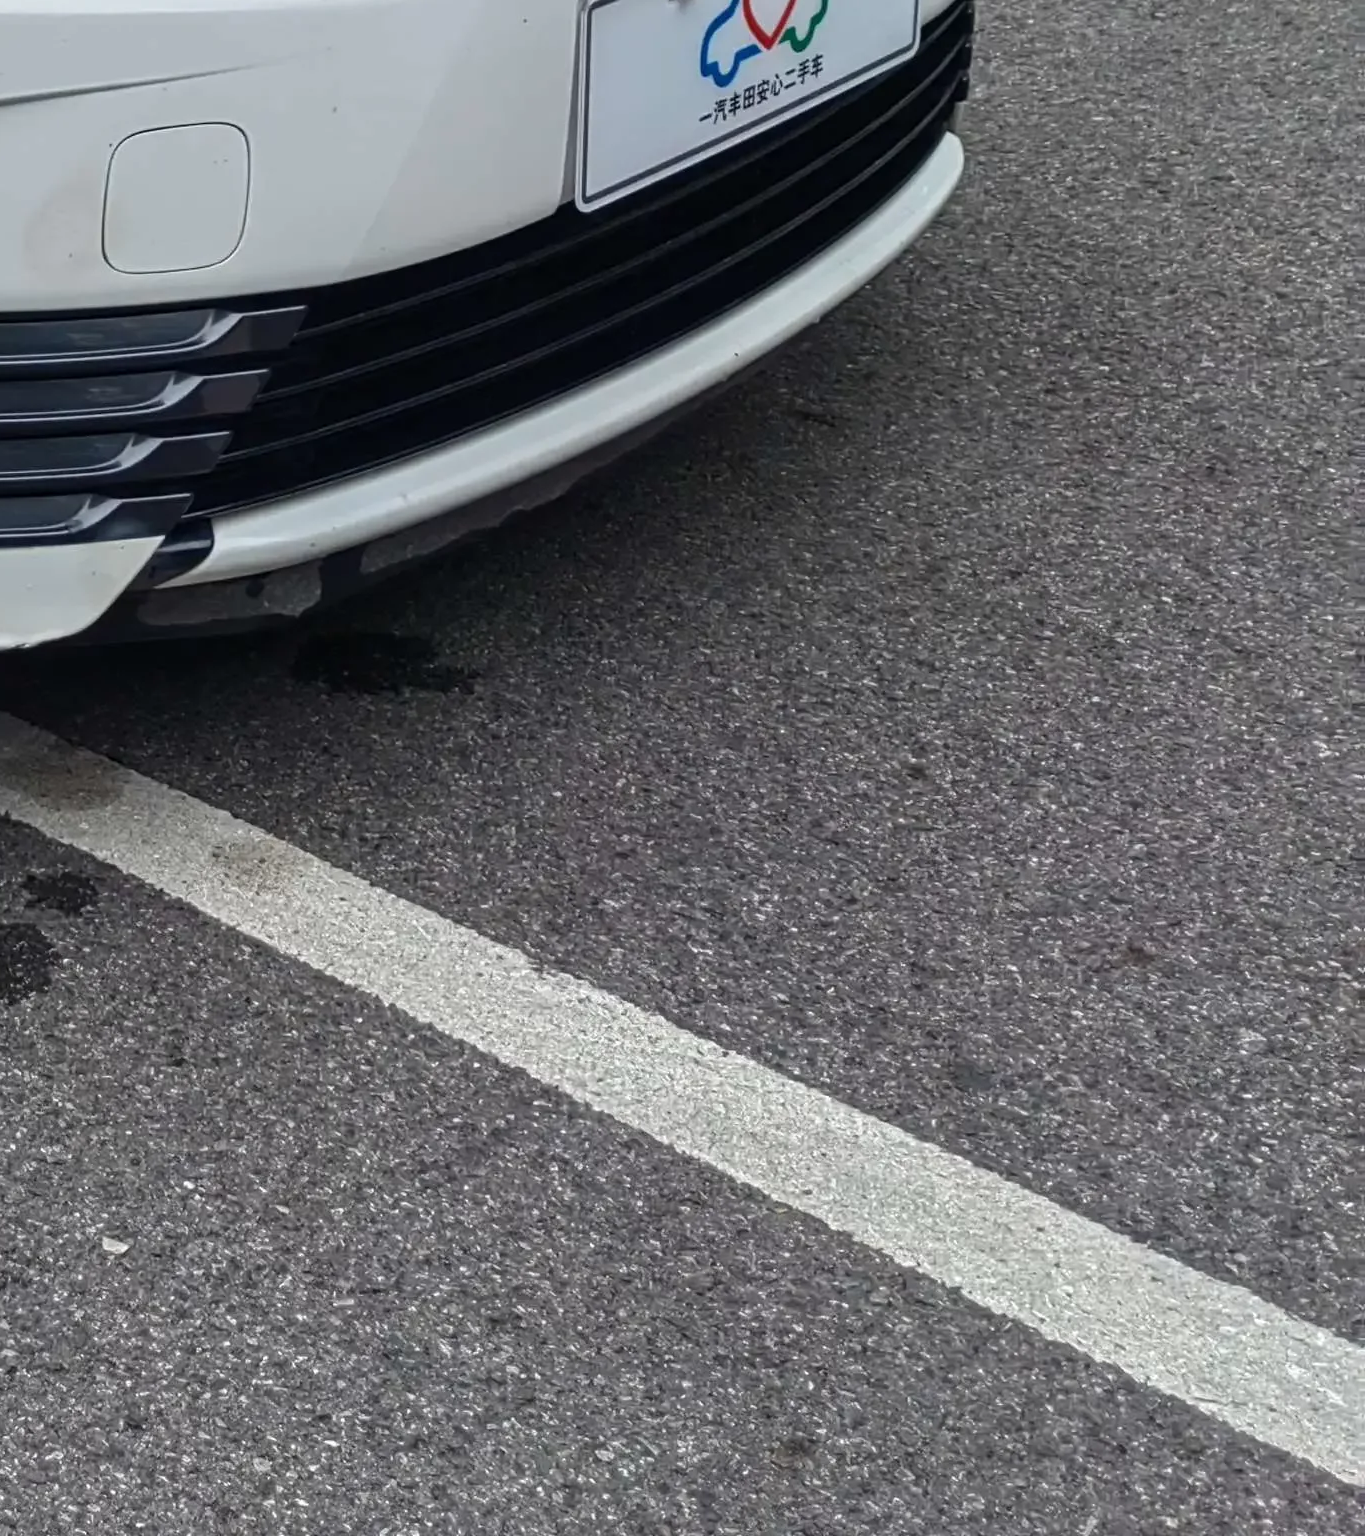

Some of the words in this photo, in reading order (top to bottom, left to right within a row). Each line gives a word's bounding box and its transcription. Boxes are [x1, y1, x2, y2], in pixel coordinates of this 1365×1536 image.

[699, 54, 825, 125] 一汽丰田安心二手车
